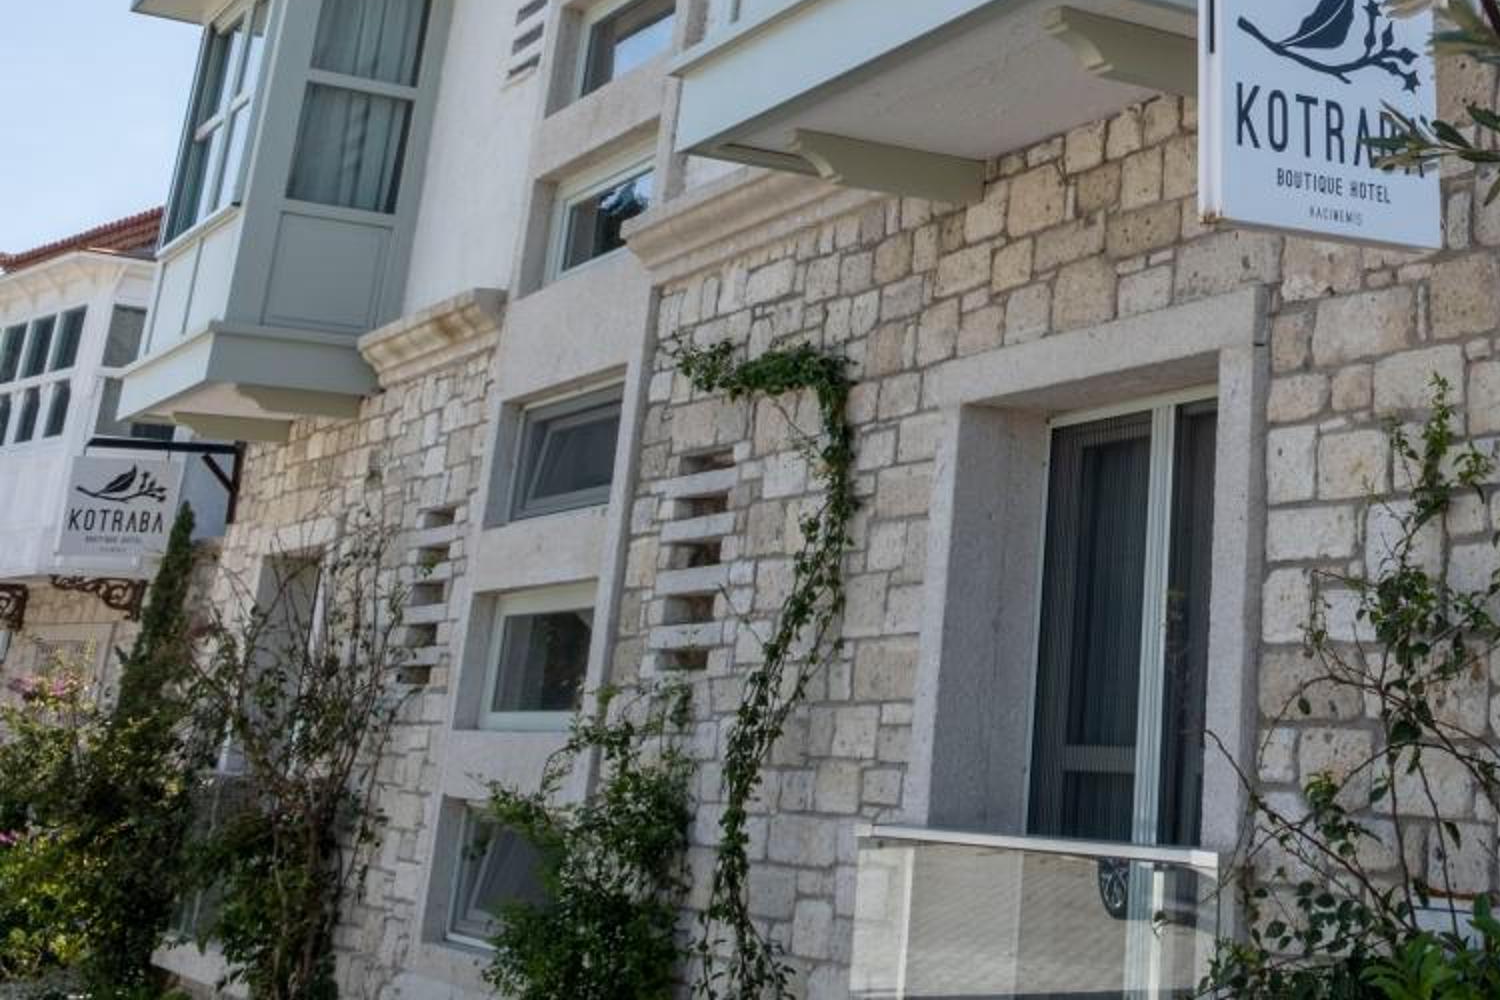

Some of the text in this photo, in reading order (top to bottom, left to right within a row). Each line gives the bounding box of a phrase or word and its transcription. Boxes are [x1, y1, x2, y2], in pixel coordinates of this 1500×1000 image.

[1276, 166, 1392, 205] BOUTIQUE HOTEL
[68, 508, 163, 534] KOTRABA
